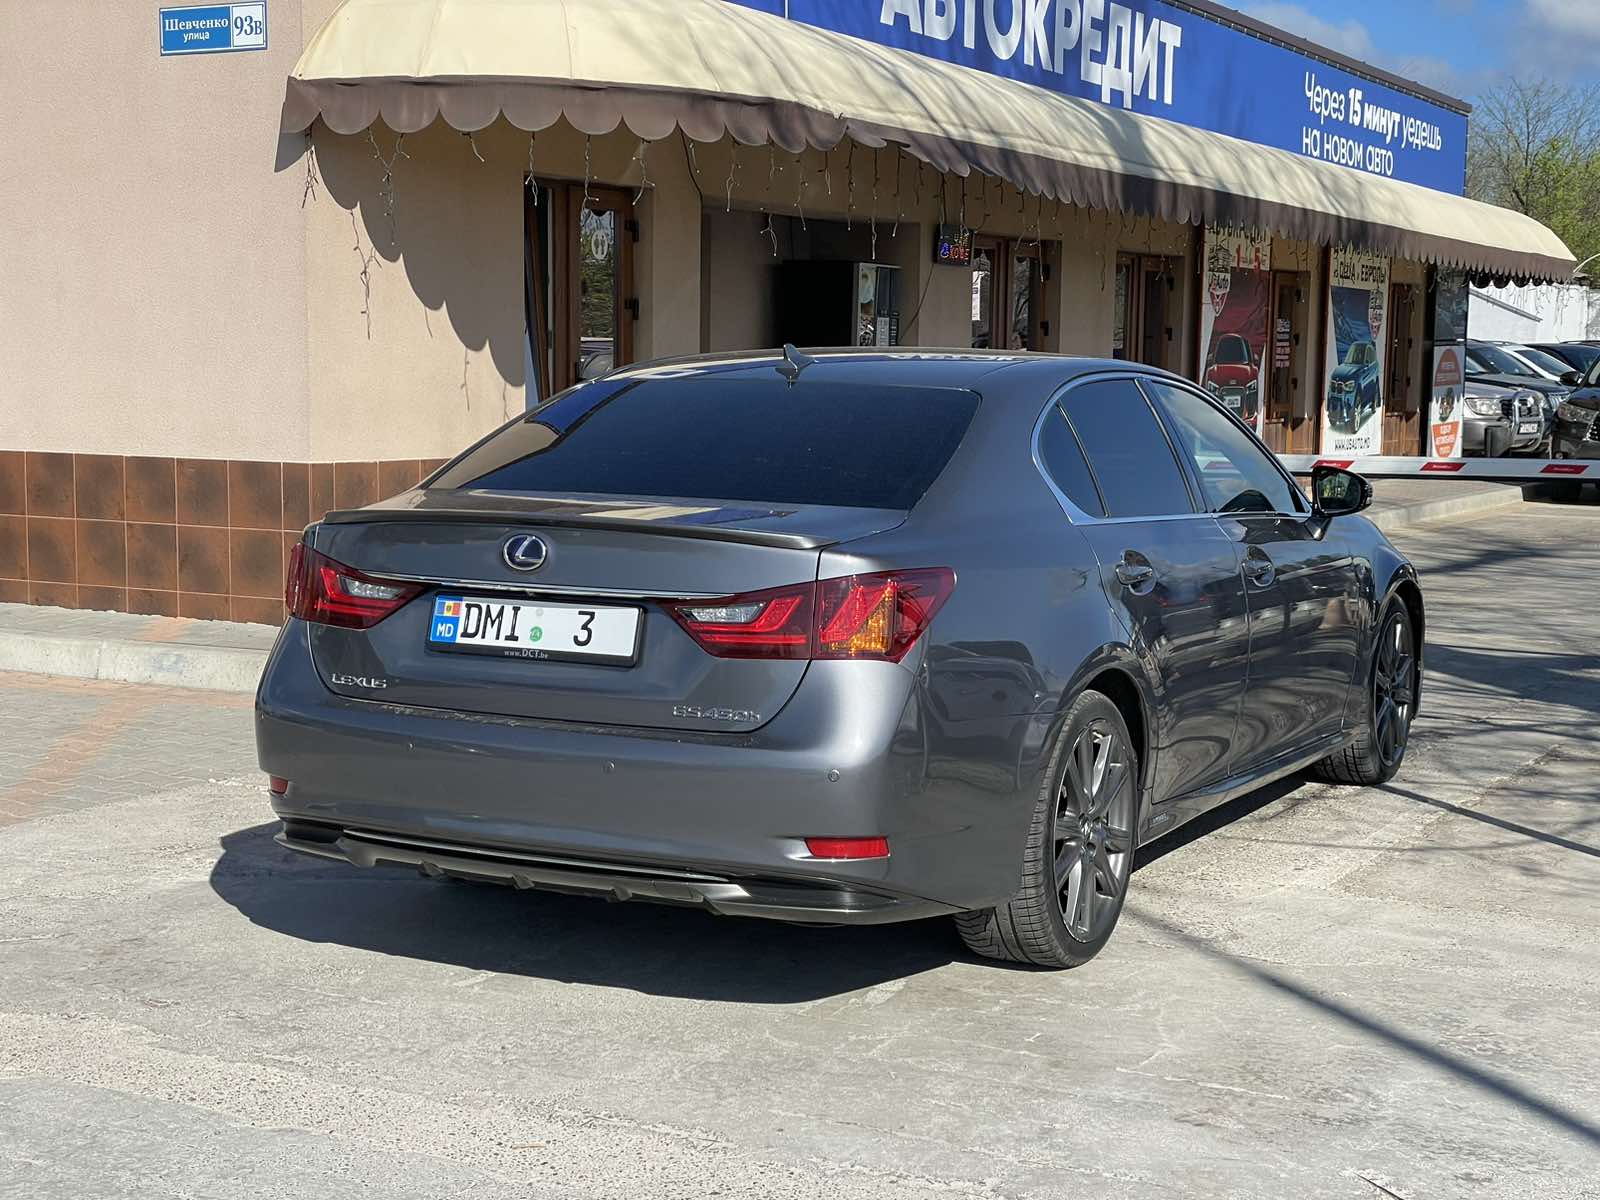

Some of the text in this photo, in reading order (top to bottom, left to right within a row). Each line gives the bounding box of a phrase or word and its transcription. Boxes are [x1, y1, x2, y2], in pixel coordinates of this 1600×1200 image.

[164, 18, 229, 31] Шевченко
[183, 31, 210, 43] улица
[880, 0, 1182, 109] ОКРЕДИТ
[1304, 72, 1345, 125] Через
[1348, 88, 1363, 126] 15
[1401, 115, 1442, 151] уедешь
[436, 623, 454, 636] MD
[460, 603, 595, 647] DMI 3
[332, 673, 387, 688] LEXUS
